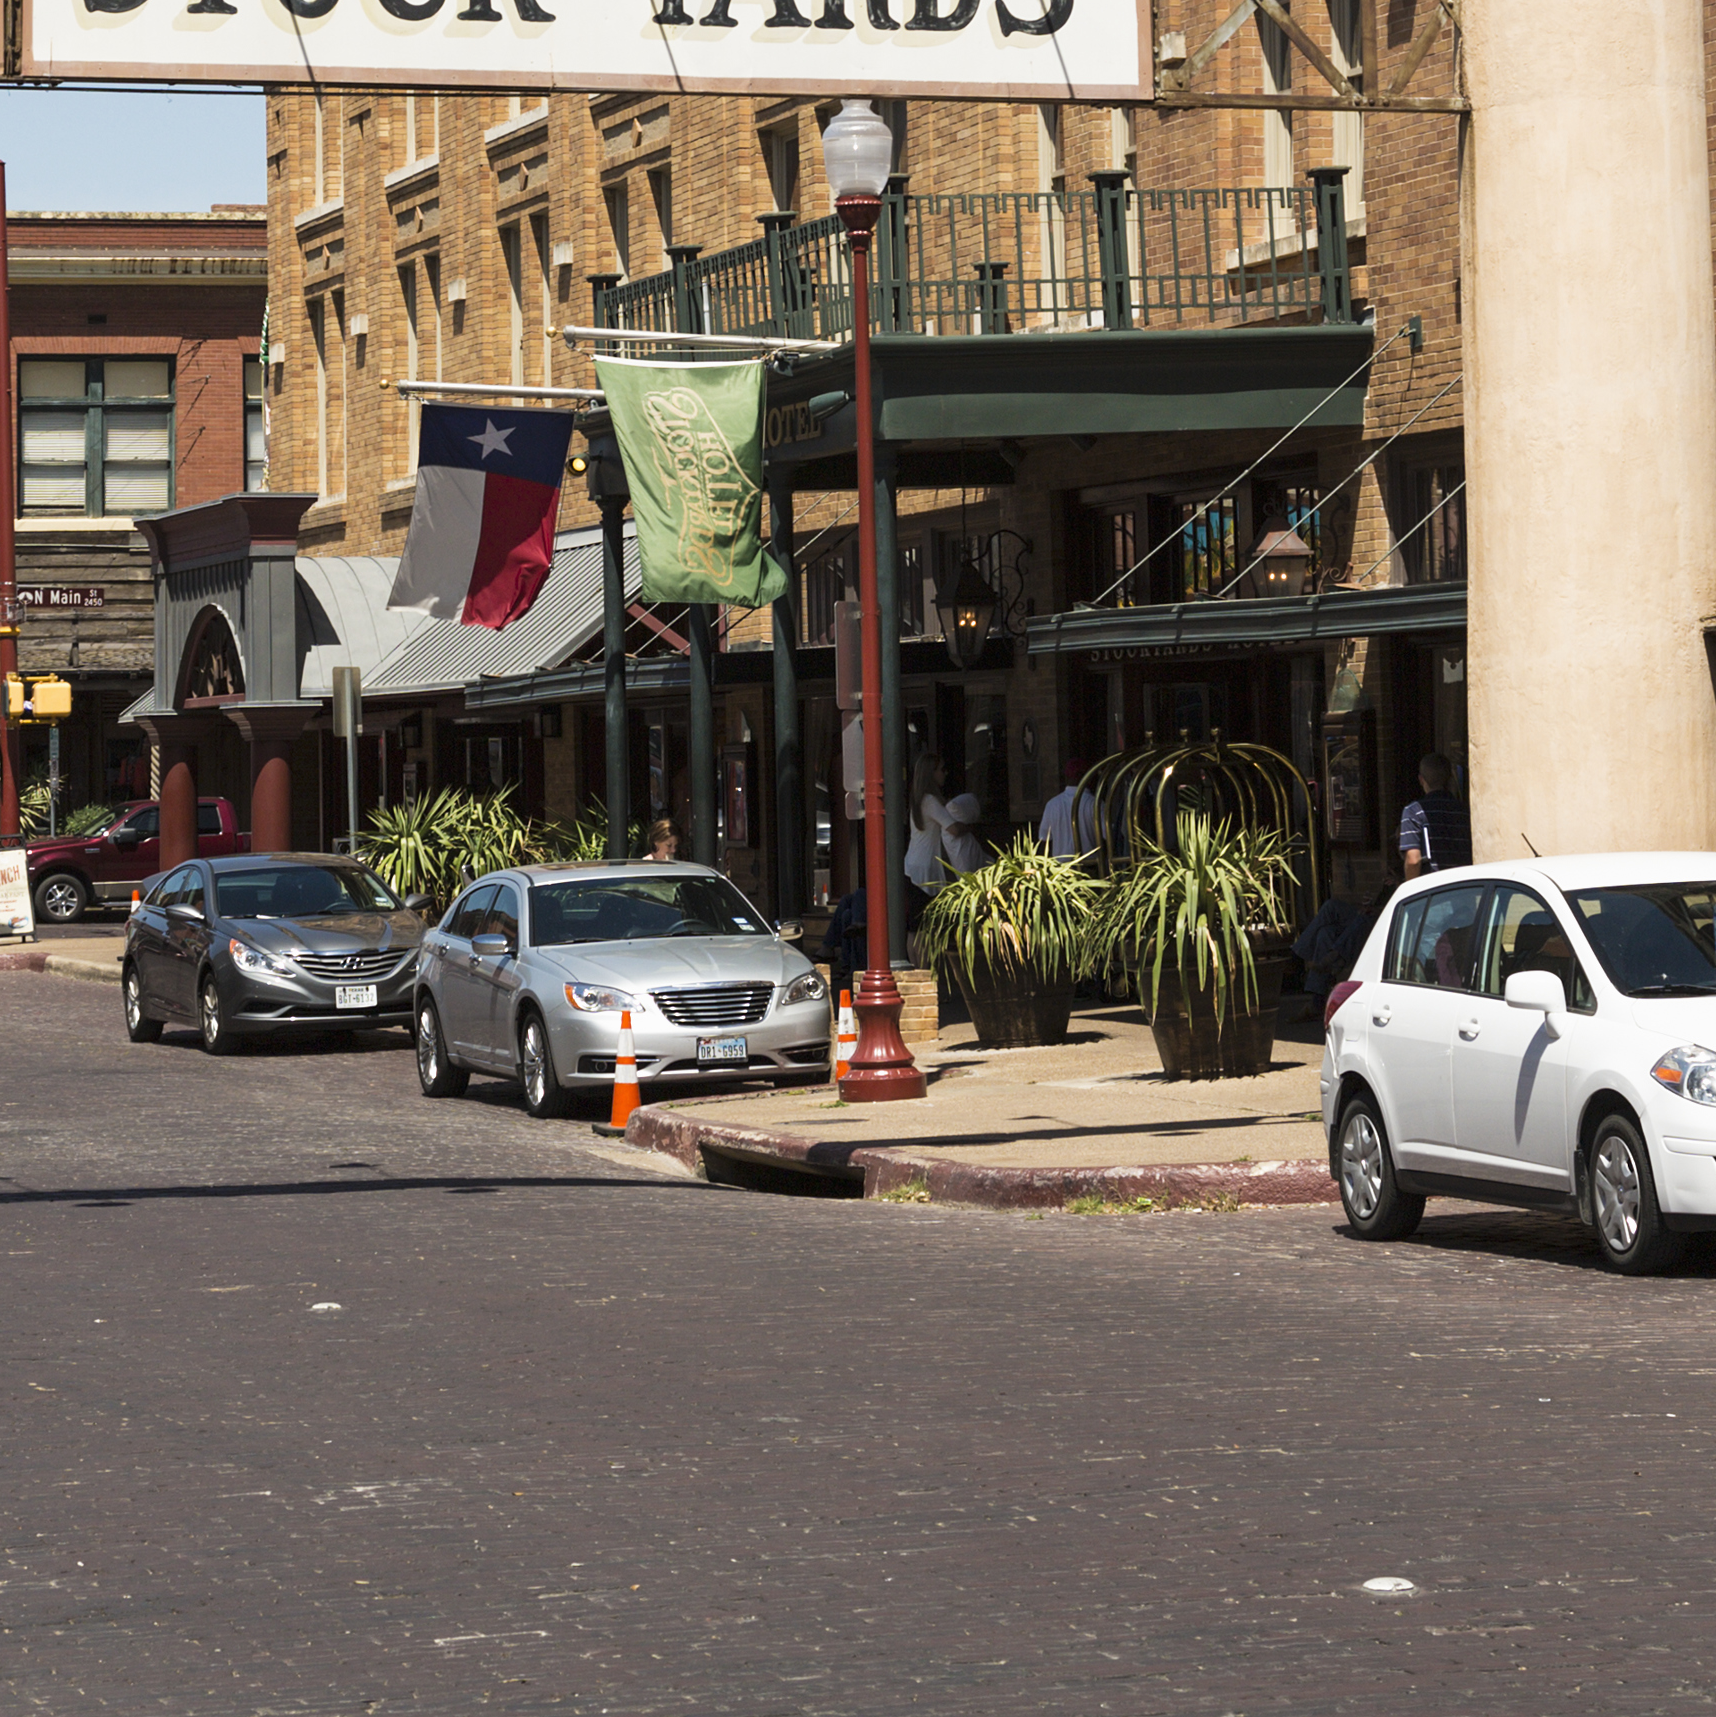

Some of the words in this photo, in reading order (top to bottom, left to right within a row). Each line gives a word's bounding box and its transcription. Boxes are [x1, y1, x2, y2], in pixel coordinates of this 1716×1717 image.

[34, 590, 44, 604] N
[50, 589, 81, 604] Main
[89, 589, 97, 597] St
[84, 597, 103, 606] 2450
